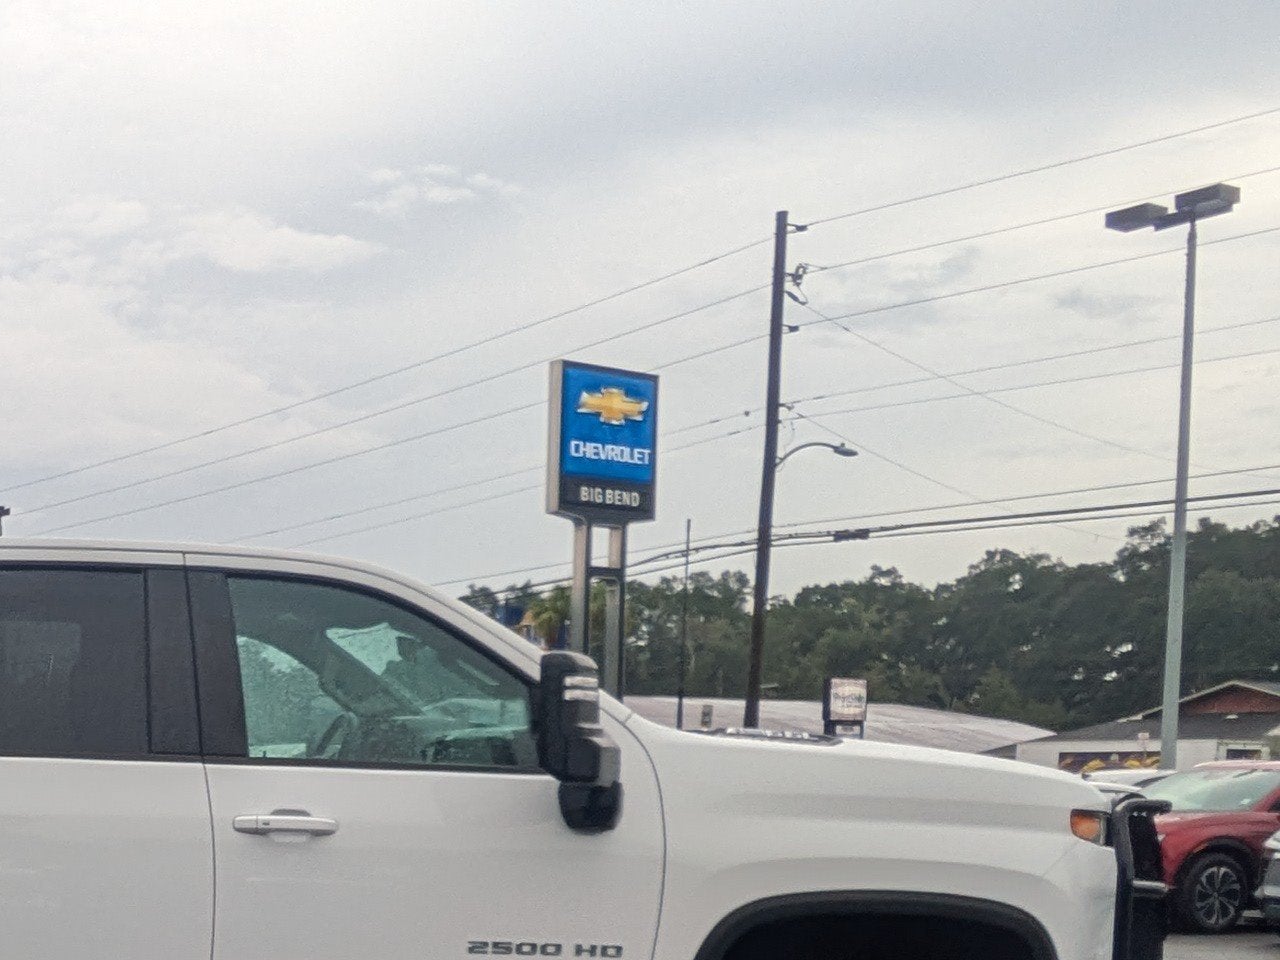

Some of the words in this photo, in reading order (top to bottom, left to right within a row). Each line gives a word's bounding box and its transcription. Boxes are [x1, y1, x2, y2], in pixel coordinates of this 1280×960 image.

[569, 439, 651, 465] CHEVROLET
[580, 486, 604, 504] BIG
[605, 489, 640, 508] BEND
[467, 941, 563, 956] 2500
[574, 943, 624, 958] HD
